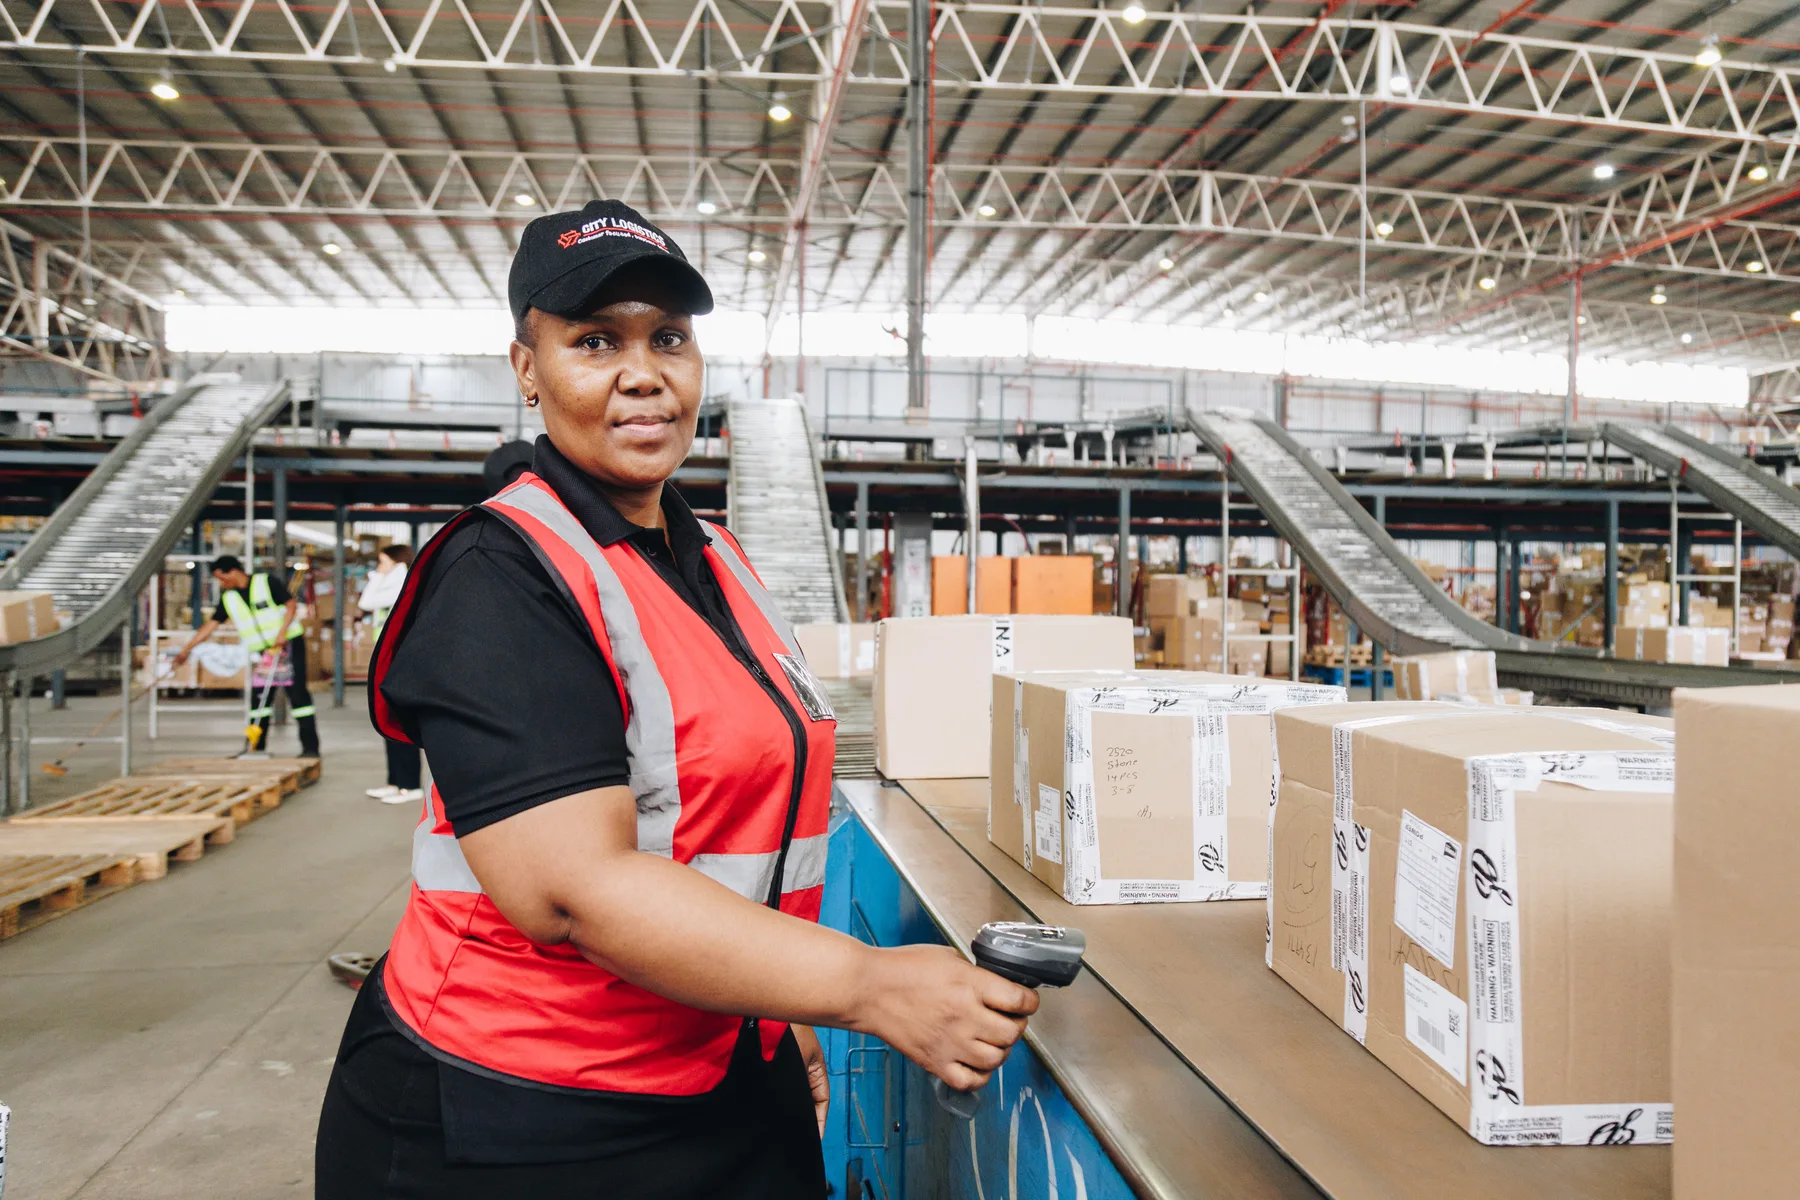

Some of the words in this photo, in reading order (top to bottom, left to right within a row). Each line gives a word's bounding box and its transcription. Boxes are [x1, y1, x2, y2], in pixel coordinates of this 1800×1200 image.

[581, 217, 608, 234] CITY
[611, 217, 666, 246] LOGISTICS
[1106, 747, 1133, 757] 2520
[1405, 824, 1423, 840] POWER
[1487, 923, 1495, 968] WARNING
[1488, 975, 1498, 1020] WARNING
[1517, 1133, 1560, 1141] WARNING
